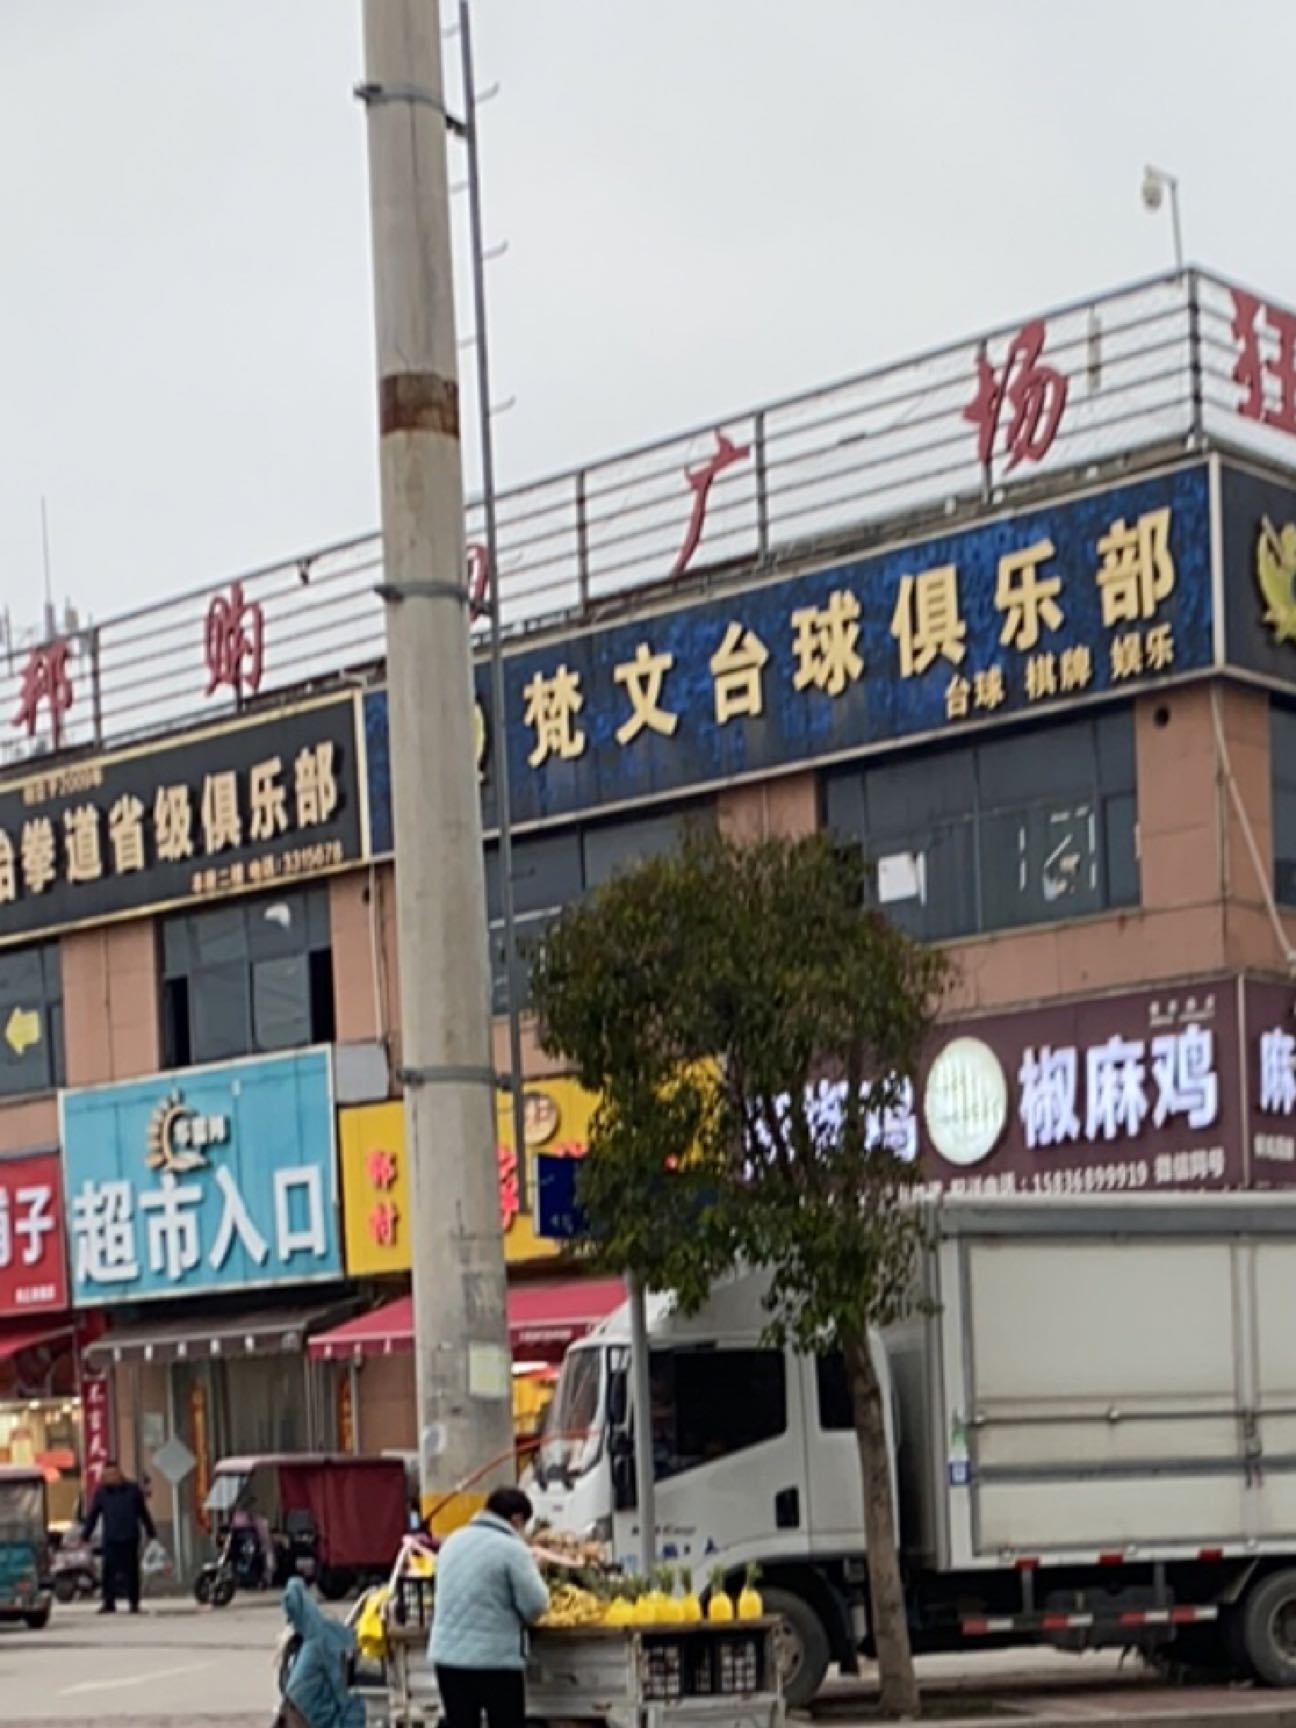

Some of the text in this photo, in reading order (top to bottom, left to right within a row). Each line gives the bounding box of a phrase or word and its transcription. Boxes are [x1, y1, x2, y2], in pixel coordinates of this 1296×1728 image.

[522, 507, 1178, 768] 梵文台球俱乐部
[1018, 1023, 1218, 1149] 椒麻鸡
[73, 1163, 328, 1283] 超市入口
